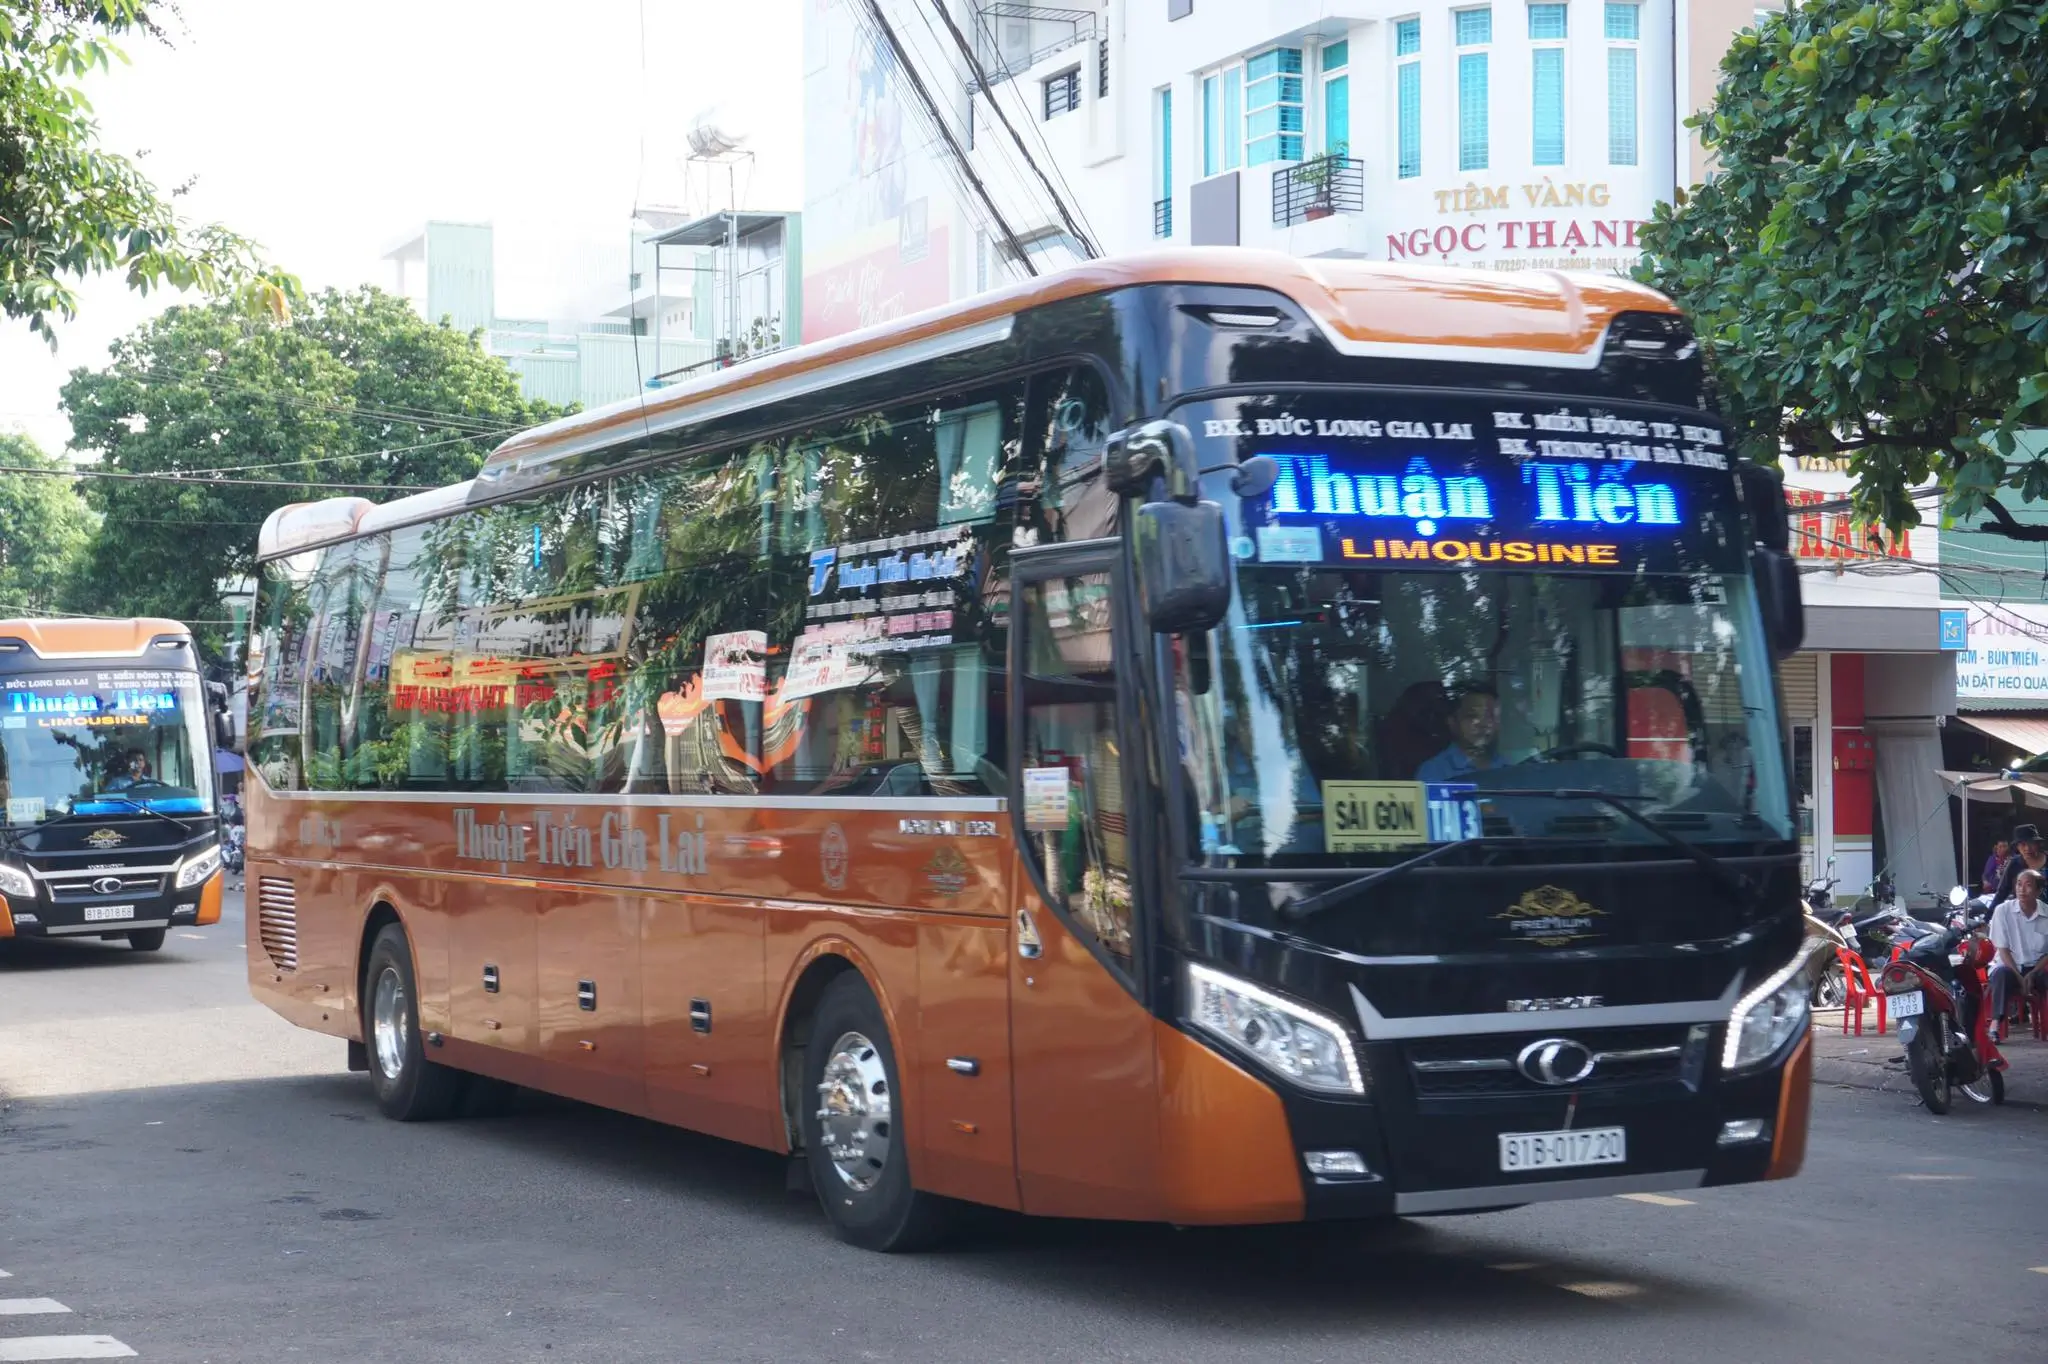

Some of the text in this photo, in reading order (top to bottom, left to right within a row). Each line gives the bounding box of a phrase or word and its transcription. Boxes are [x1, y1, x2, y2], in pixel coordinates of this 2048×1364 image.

[1434, 175, 1611, 217] TIỆM VÀNG
[1386, 222, 1487, 261] NGỌC
[1256, 412, 1313, 438] ĐỨC
[1315, 419, 1382, 438] LONG
[1384, 421, 1431, 439] GIA
[1432, 422, 1475, 440] LAI
[1258, 454, 1682, 536] Thuận Tiến
[1341, 538, 1620, 564] LIMOUSINE
[1997, 676, 2021, 689] HEO
[2023, 676, 2048, 690] QUA
[8, 688, 176, 717] Thuận Tiến
[38, 715, 149, 727] LIMOUSINE
[452, 807, 708, 875] Thuận Tiến Gia Lai
